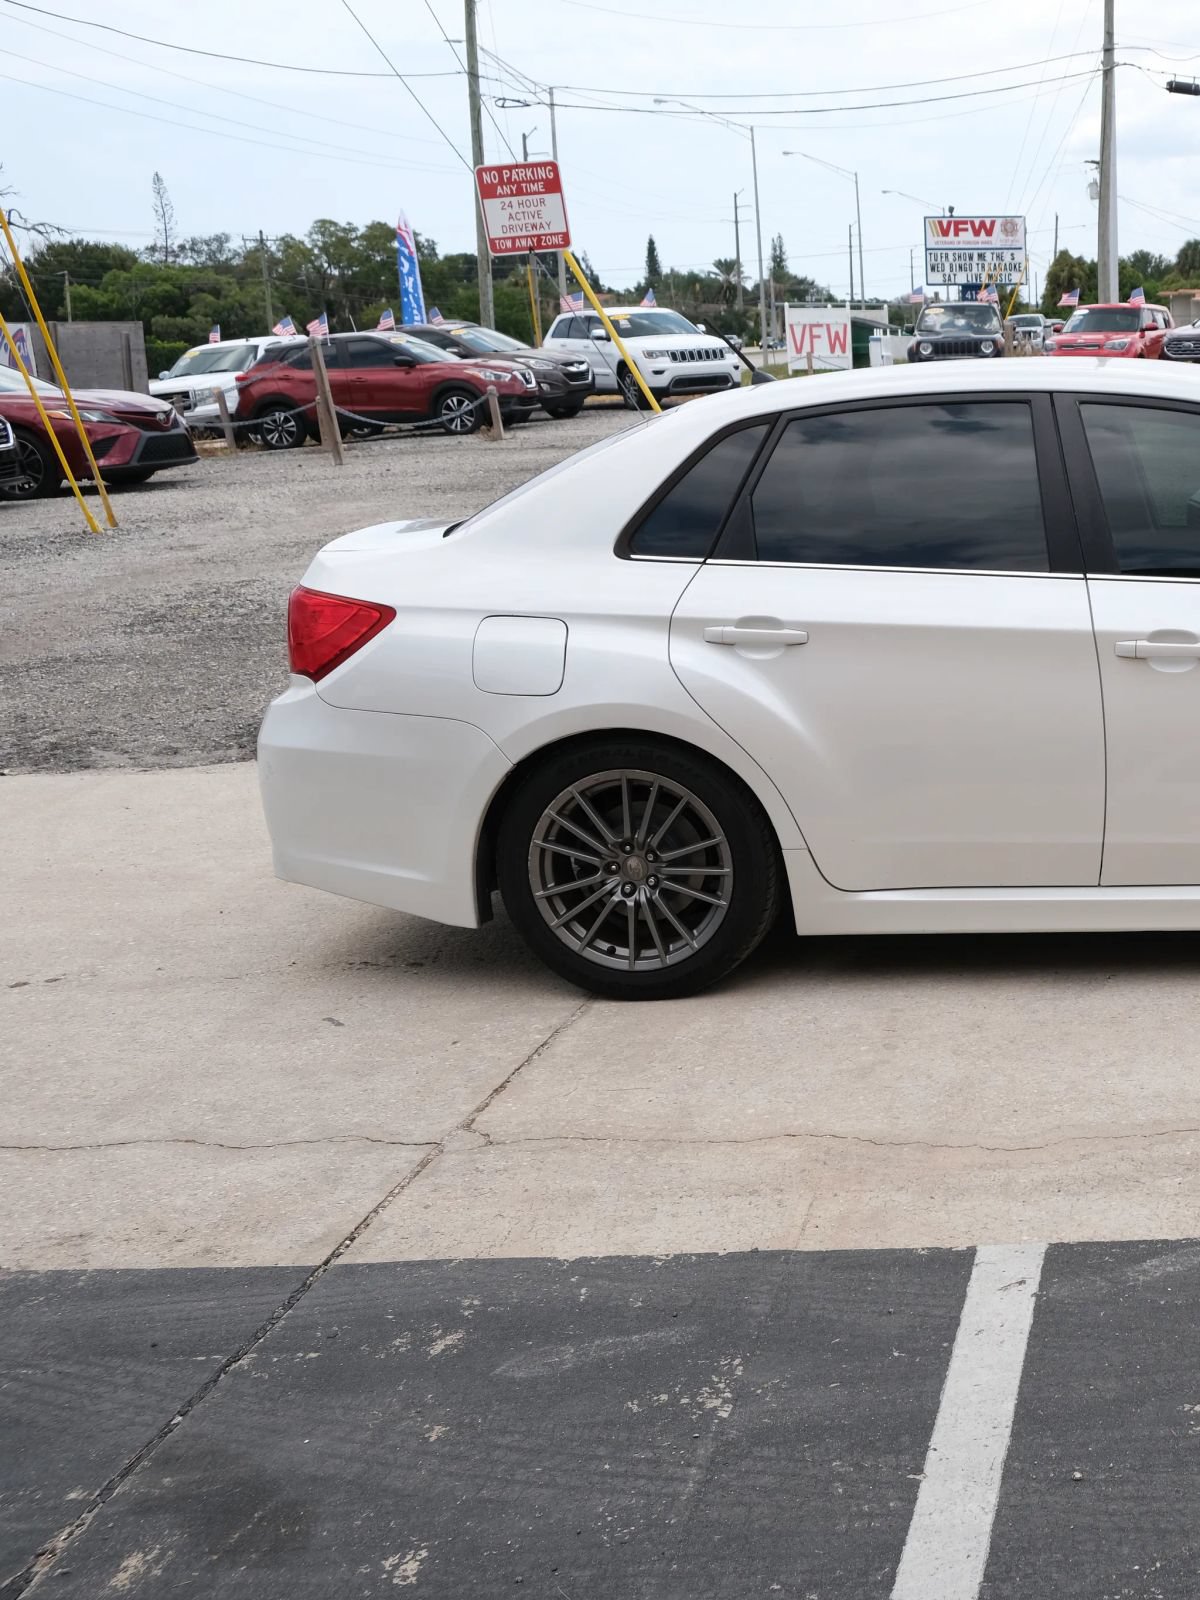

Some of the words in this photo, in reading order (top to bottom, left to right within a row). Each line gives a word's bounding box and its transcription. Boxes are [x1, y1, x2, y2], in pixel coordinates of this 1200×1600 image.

[482, 170, 499, 185] NO
[503, 166, 554, 182] PARKING
[496, 184, 517, 196] ANY
[521, 181, 546, 193] TIME
[500, 200, 513, 210] 24
[518, 198, 546, 208] HOUR
[508, 209, 543, 221] ACTIVE
[501, 221, 552, 234] DRIVEWAY
[937, 219, 997, 237] VFW
[494, 239, 512, 249] TOW
[515, 237, 538, 248] AWAY
[541, 234, 565, 246] ZONE
[952, 252, 974, 261] SHOW
[977, 252, 987, 261] ME
[991, 252, 1005, 261] THE
[930, 263, 946, 272] WED
[950, 263, 973, 272] BINGO
[942, 273, 957, 283] SAT
[966, 273, 983, 282] LIVE
[987, 272, 1013, 282] MUSIC
[789, 323, 848, 354] VFW
